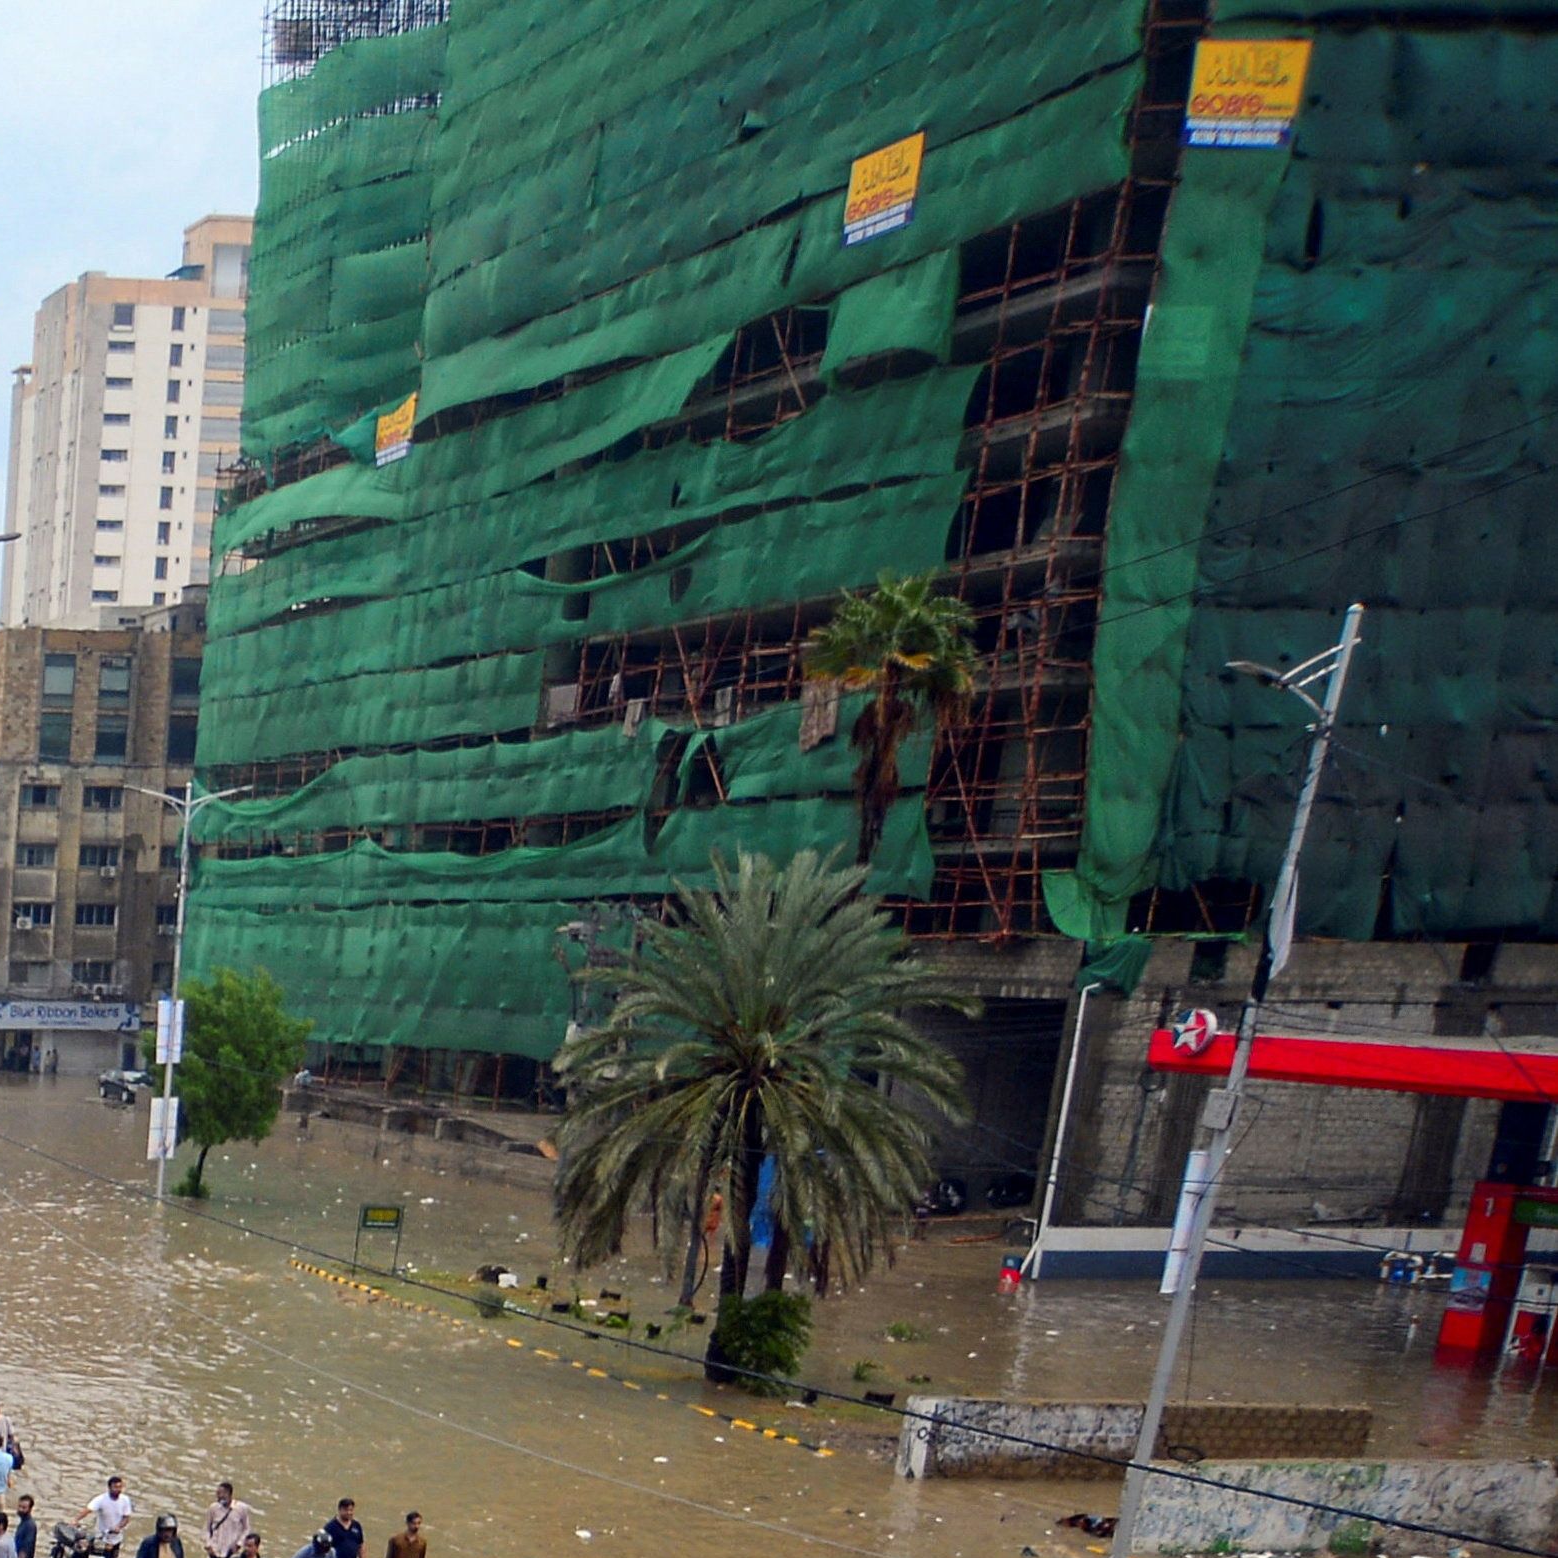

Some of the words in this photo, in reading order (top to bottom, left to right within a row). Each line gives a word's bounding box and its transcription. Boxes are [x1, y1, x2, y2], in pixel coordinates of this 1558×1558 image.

[10, 1005, 33, 1018] Blue
[37, 1005, 76, 1018] Ribbon
[80, 1005, 119, 1018] Bakers
